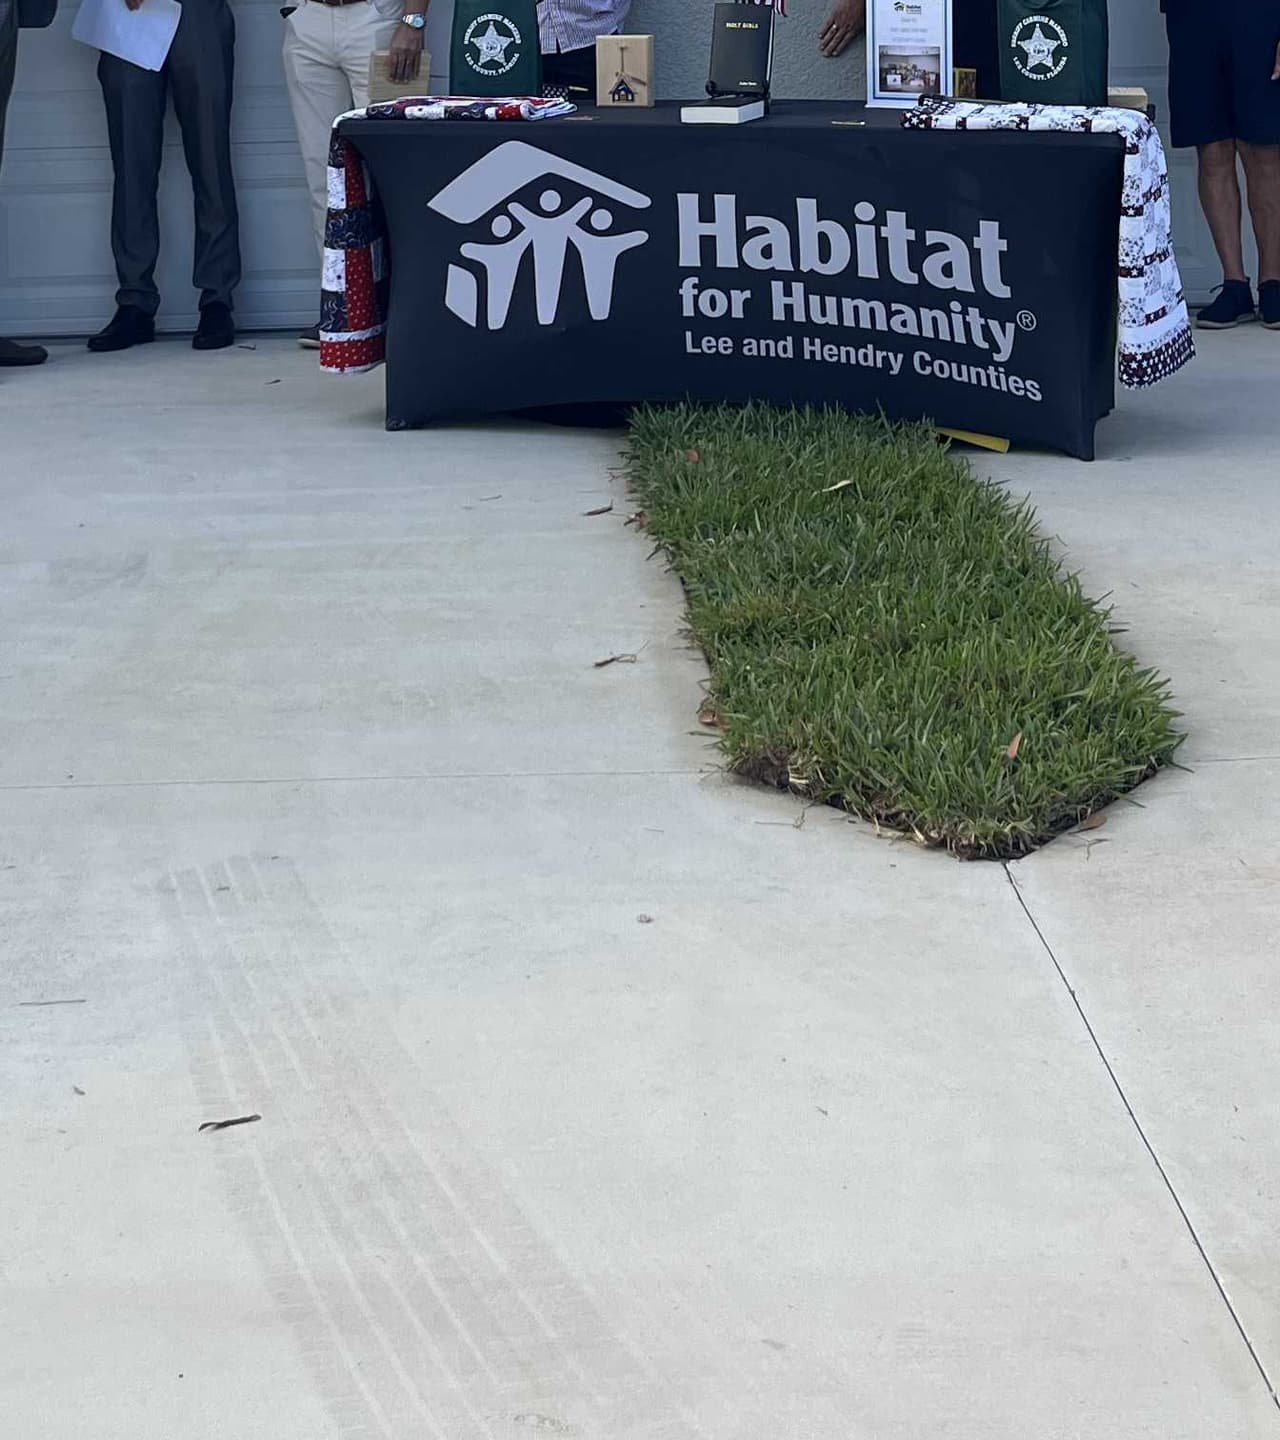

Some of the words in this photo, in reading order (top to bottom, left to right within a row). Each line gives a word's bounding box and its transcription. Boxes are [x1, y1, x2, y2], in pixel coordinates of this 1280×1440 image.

[676, 192, 1012, 299] Habitat
[678, 276, 751, 319] for
[685, 331, 734, 355] Lee
[742, 335, 794, 359] and
[802, 336, 904, 375] Hendry
[913, 350, 1043, 402] Counties
